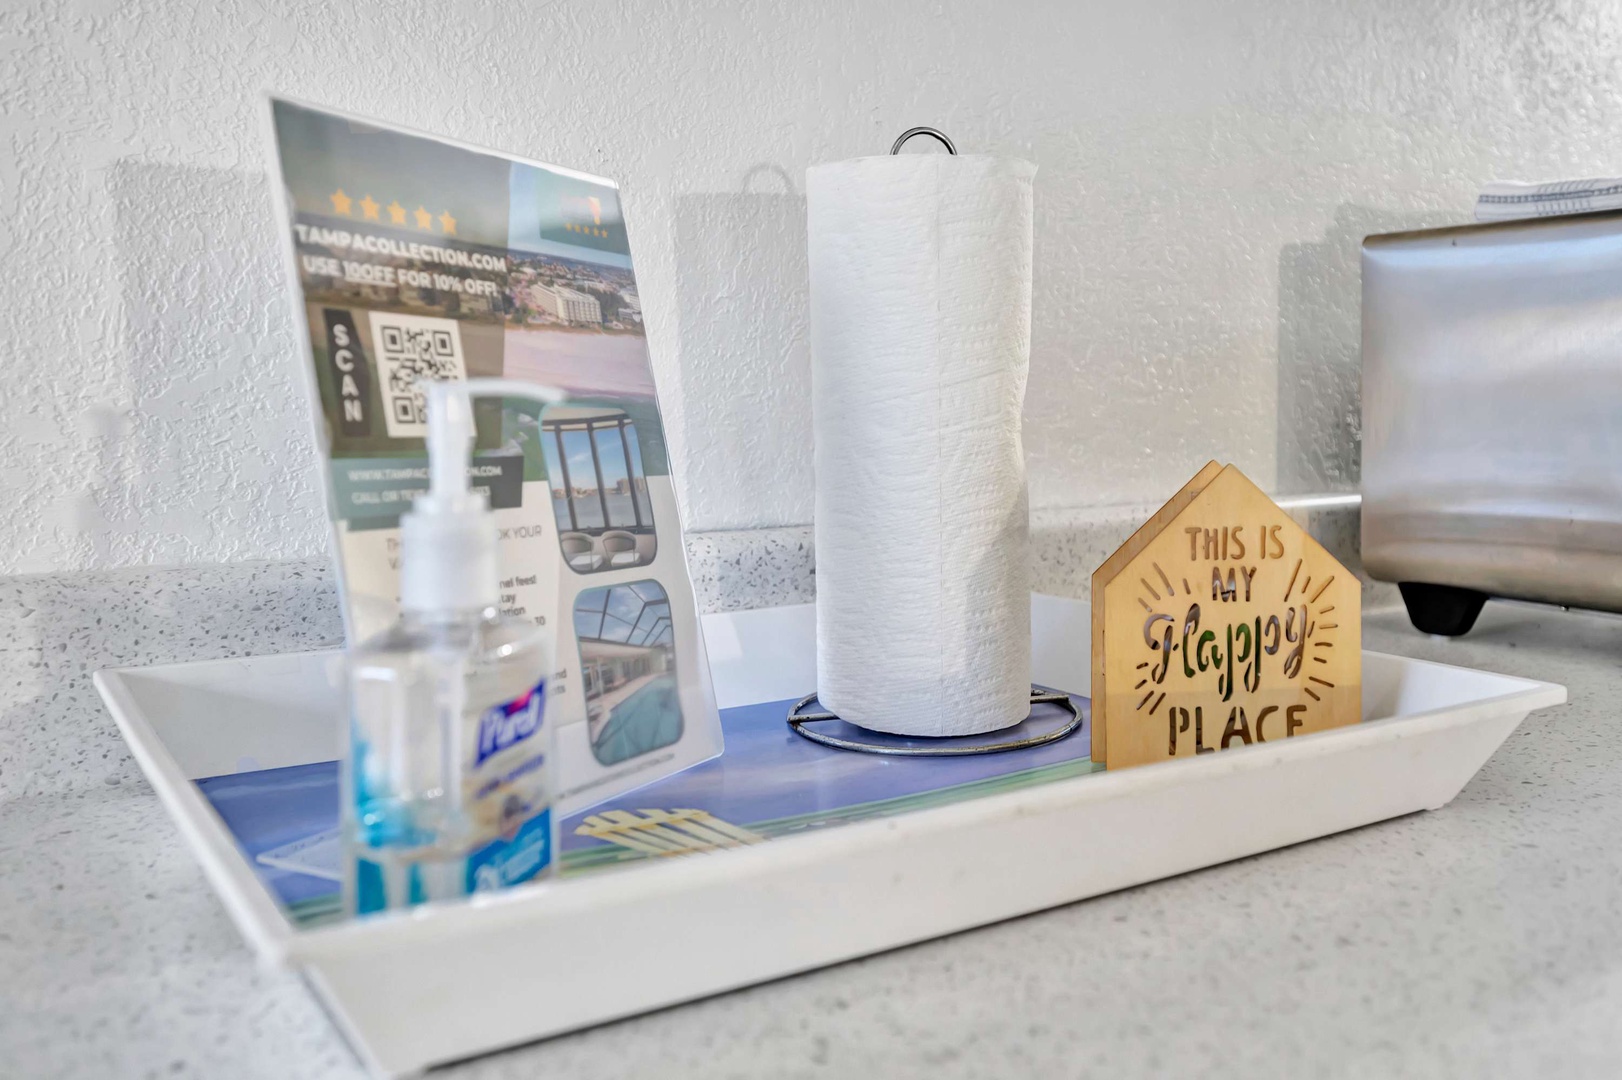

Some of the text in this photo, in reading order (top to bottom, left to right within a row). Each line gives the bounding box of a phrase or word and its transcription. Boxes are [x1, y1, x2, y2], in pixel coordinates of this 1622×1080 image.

[294, 223, 507, 272] TAMPACOLLECTION.COM
[303, 256, 342, 277] USE
[397, 270, 432, 289] FOR
[434, 275, 462, 293] 10%
[464, 280, 499, 296] OFF!
[333, 323, 363, 422] SCAN
[513, 525, 542, 541] YOUR
[1184, 525, 1285, 561] THIS IS
[1212, 566, 1257, 602] MY
[1143, 603, 1315, 702] Happy
